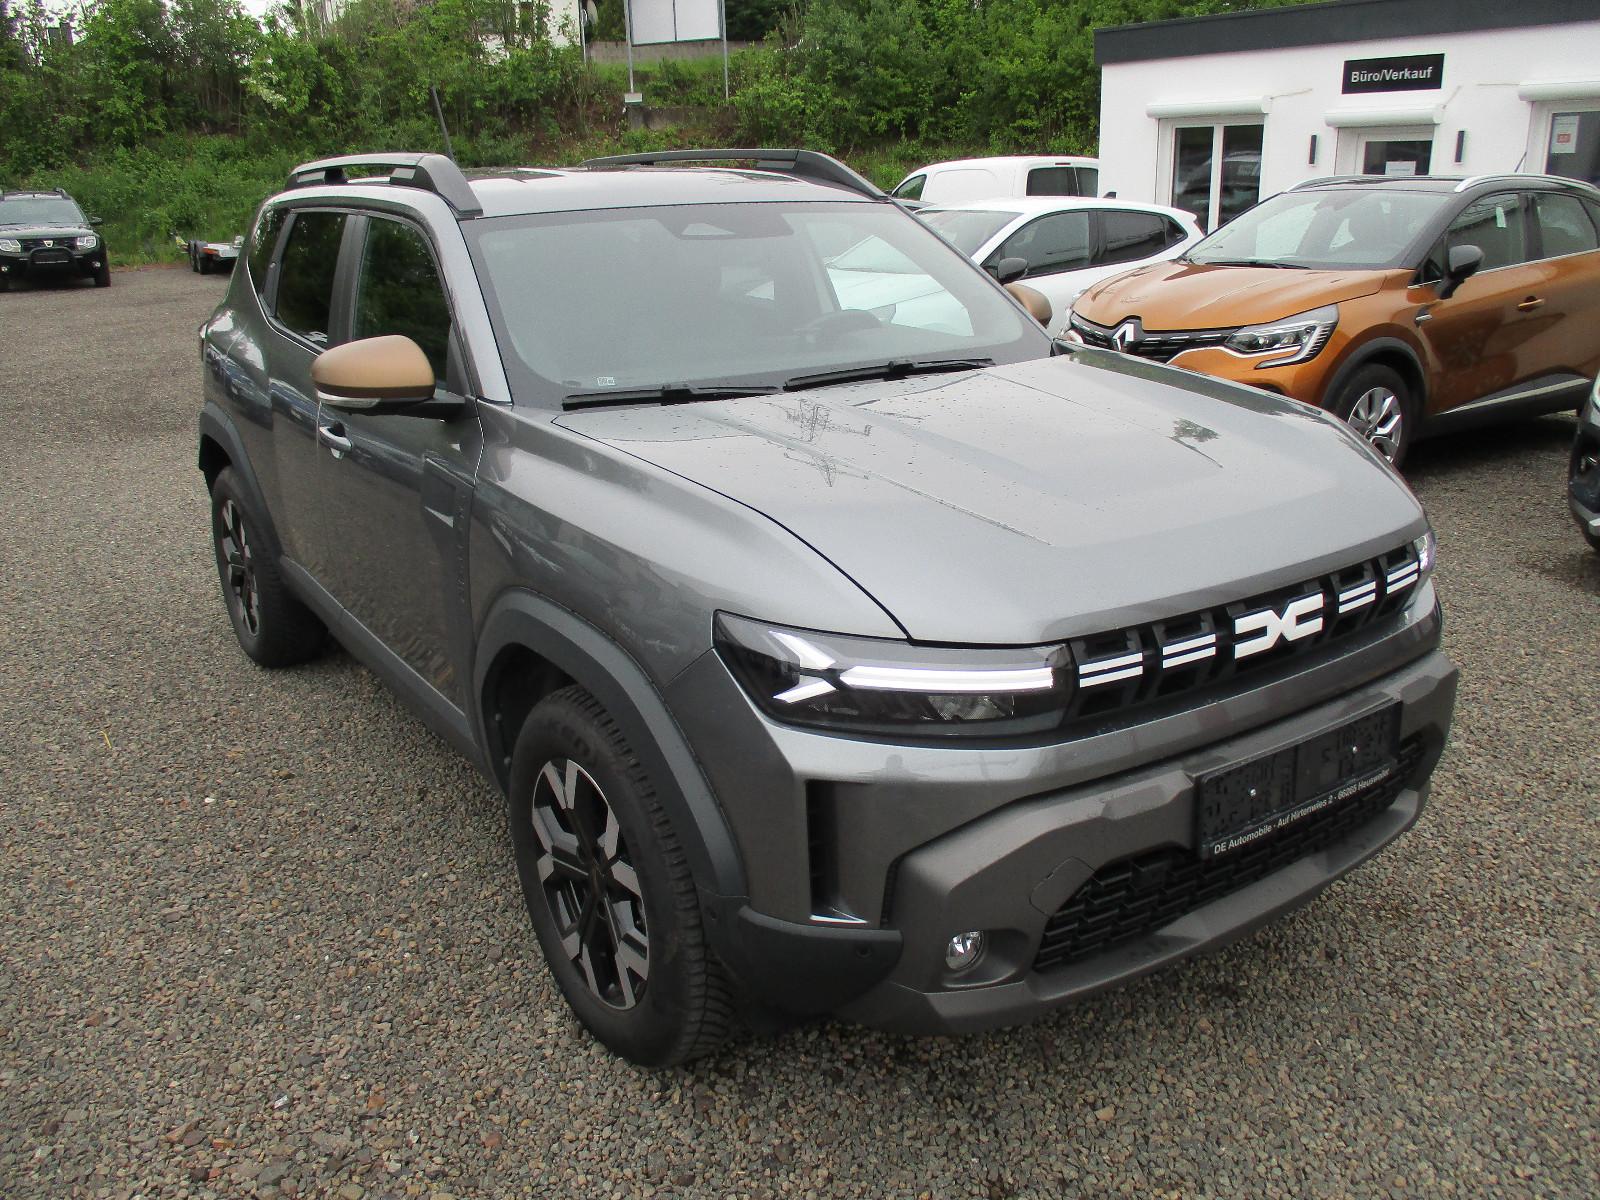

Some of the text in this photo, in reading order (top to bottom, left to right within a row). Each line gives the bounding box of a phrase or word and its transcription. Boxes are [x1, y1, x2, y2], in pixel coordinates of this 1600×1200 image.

[1351, 67, 1433, 83] Büro/Verkauf
[1214, 842, 1226, 855] DE
[1228, 824, 1272, 850] Automobile
[1277, 814, 1290, 828] Auf
